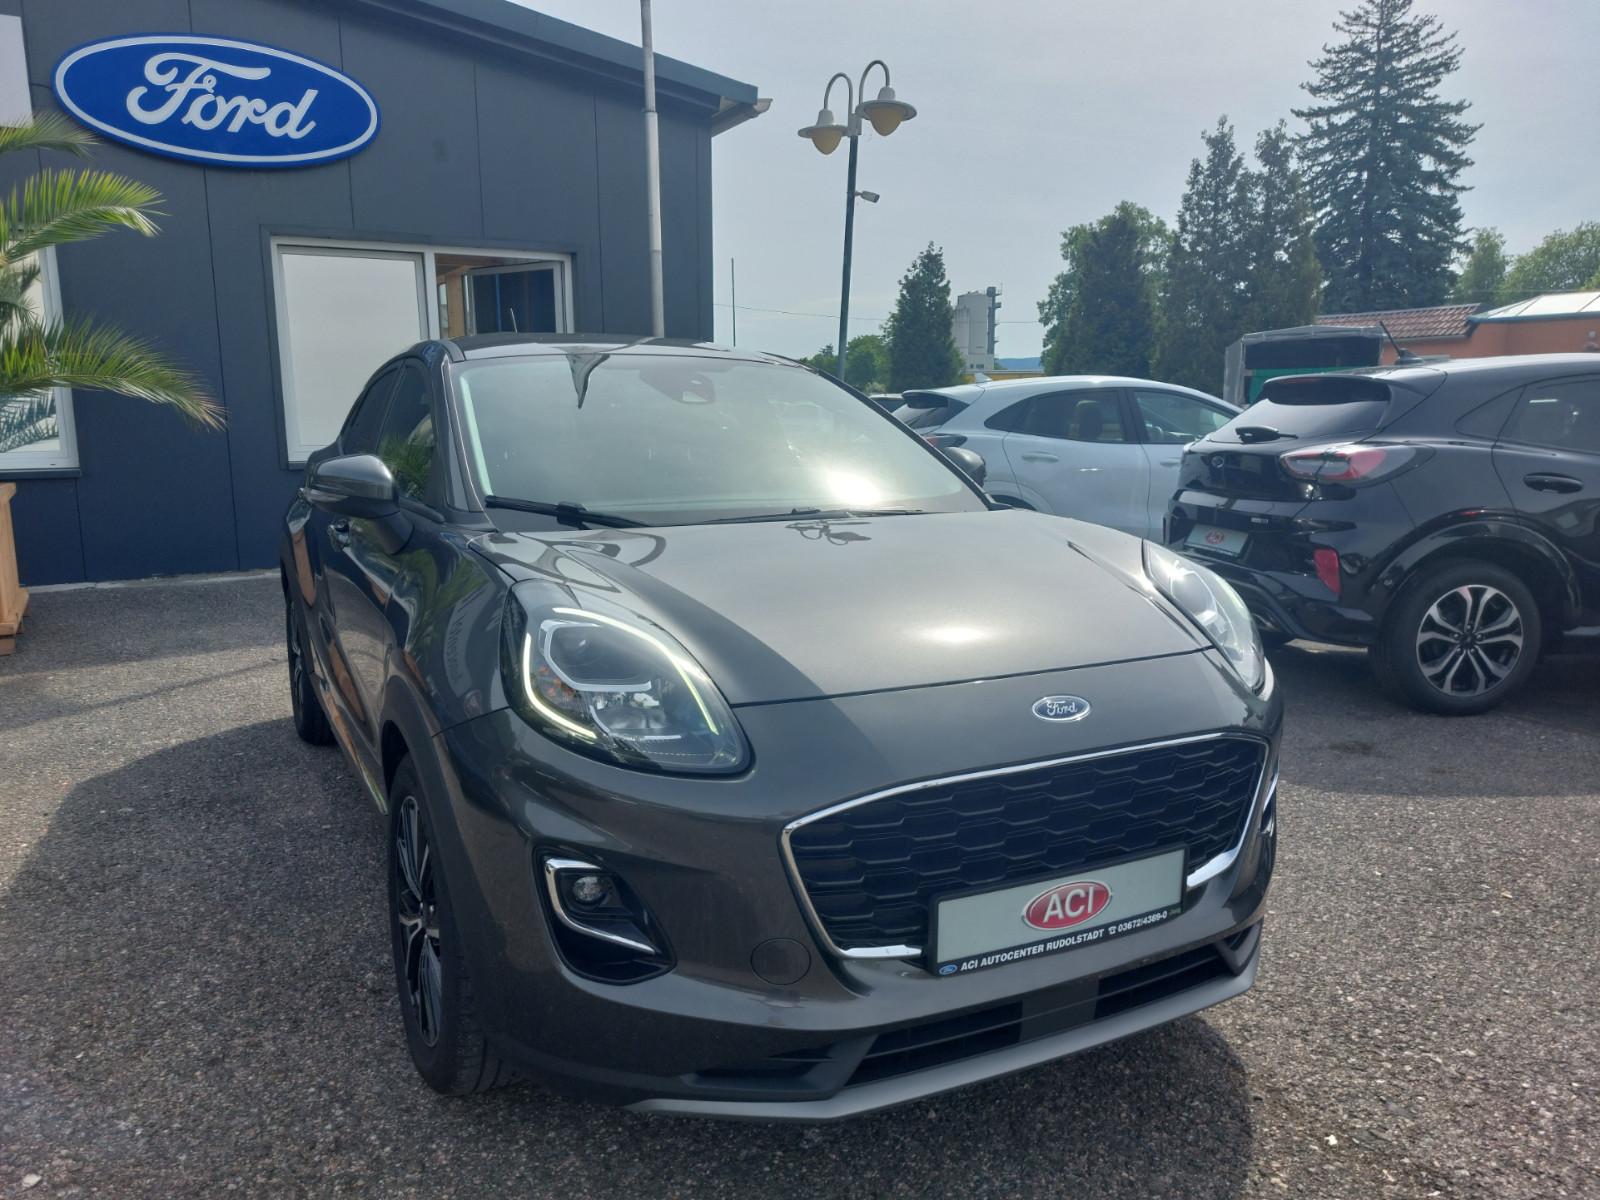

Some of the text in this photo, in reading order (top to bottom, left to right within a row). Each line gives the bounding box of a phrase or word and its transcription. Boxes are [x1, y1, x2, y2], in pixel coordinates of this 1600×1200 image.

[126, 52, 319, 139] Ford
[1046, 700, 1078, 716] Ford
[1043, 886, 1095, 923] ACI
[961, 959, 979, 972] ACI
[980, 944, 1045, 967] AUTOCENTER
[1046, 928, 1105, 951] RUDOLSTADT
